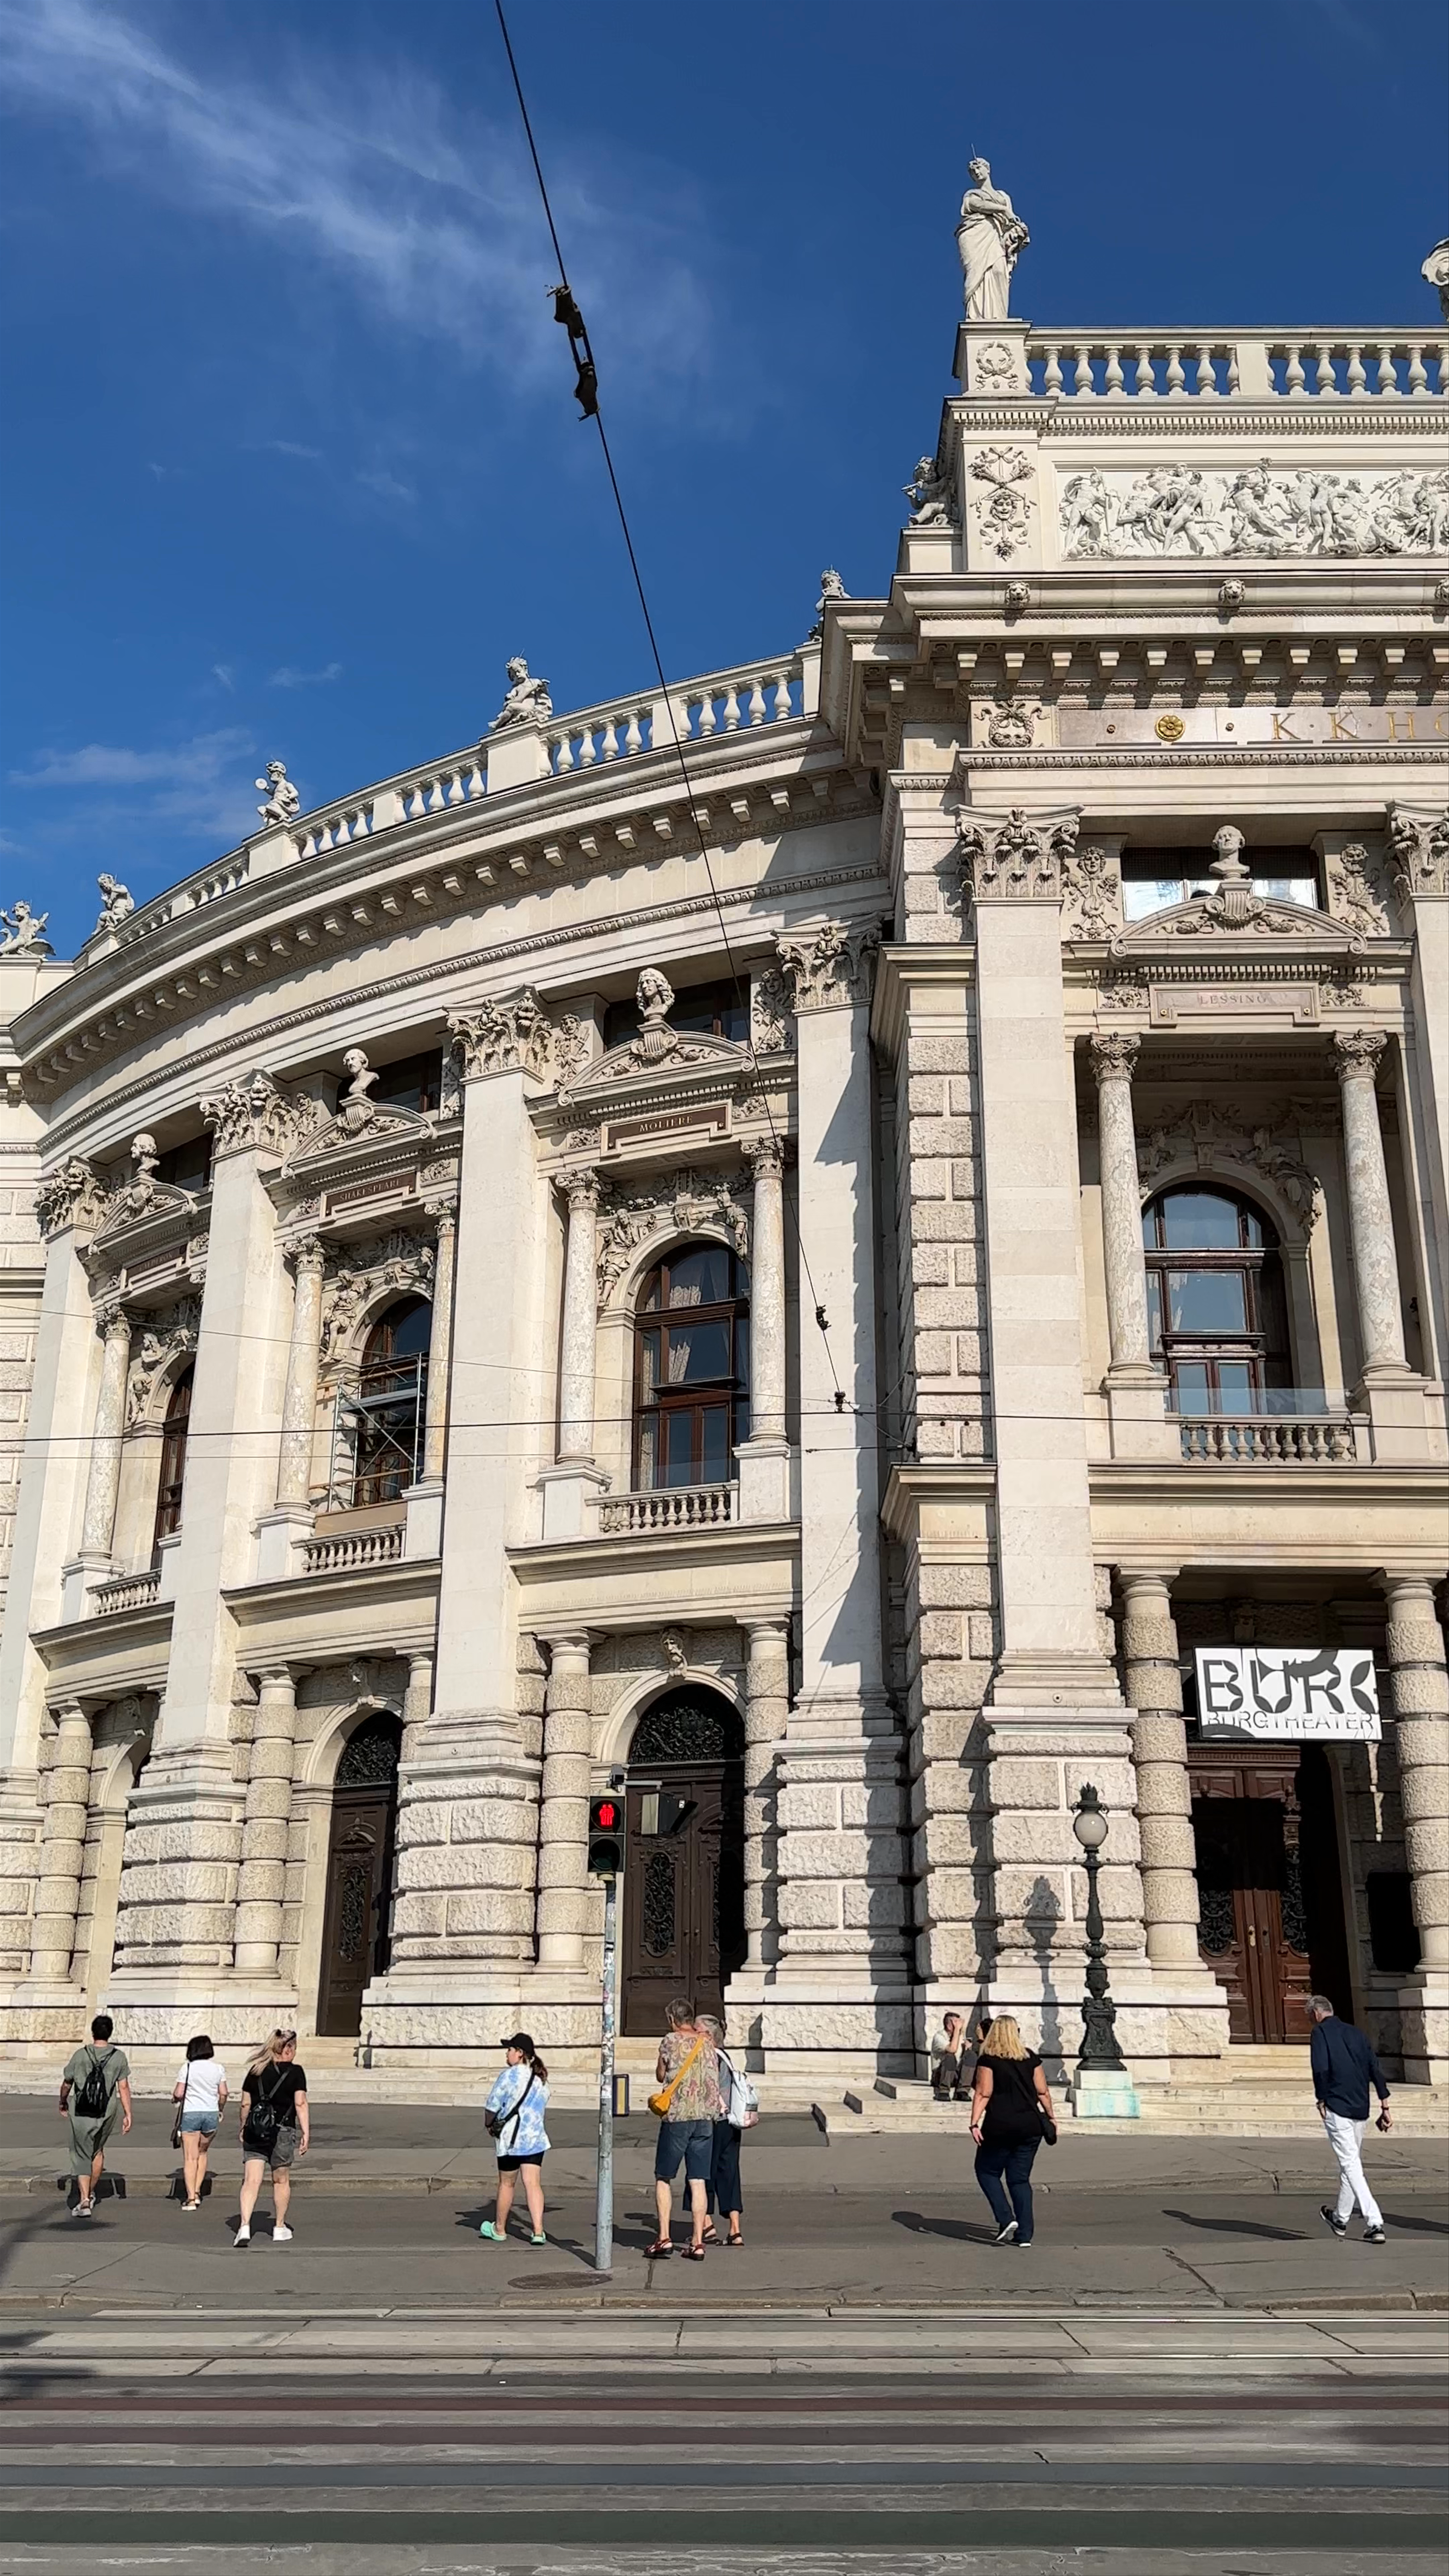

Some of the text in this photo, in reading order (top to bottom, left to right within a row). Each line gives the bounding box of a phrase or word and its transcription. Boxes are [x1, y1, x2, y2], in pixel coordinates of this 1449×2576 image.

[1200, 995, 1266, 1004] LESSING
[639, 1116, 693, 1132] MOLIERE
[340, 1179, 401, 1201] SHAKESPEARE
[1208, 1711, 1374, 1729] BURGTHEATER
